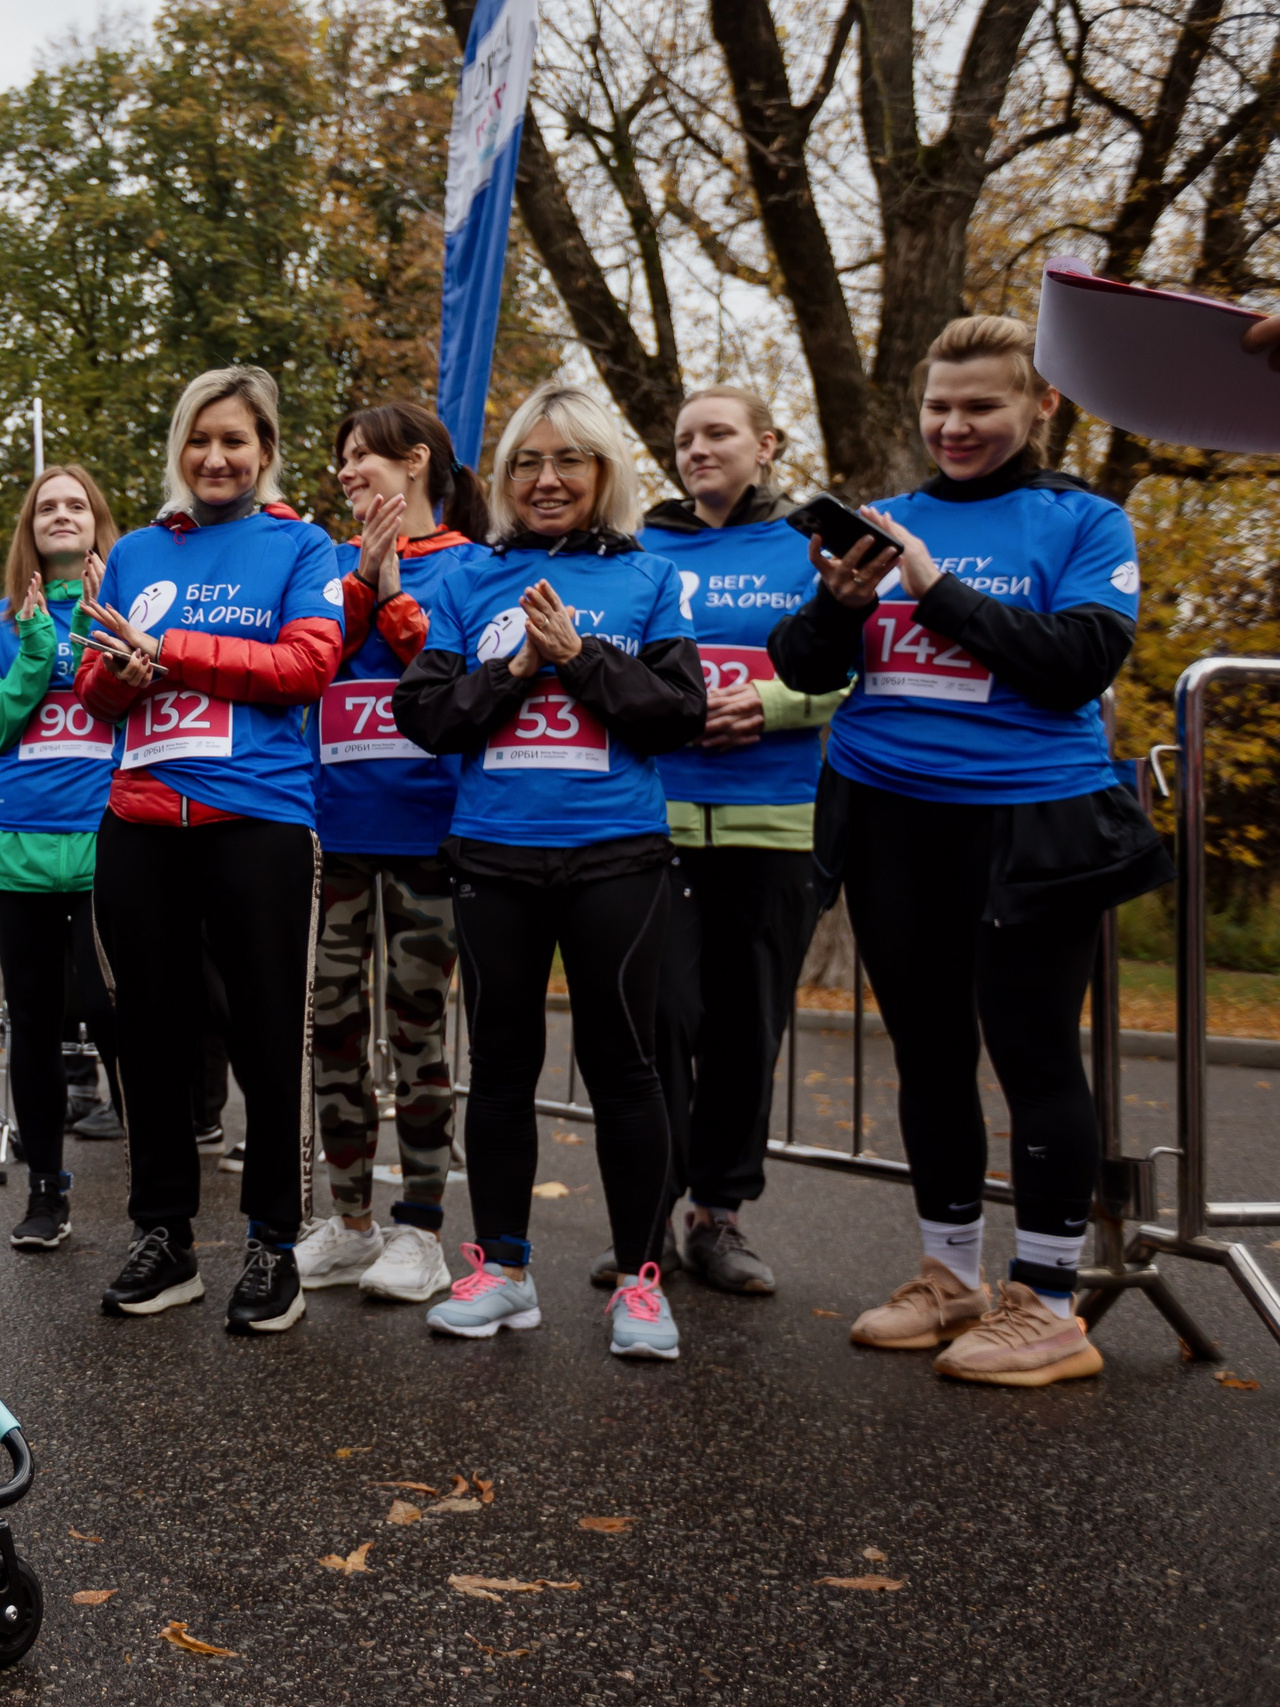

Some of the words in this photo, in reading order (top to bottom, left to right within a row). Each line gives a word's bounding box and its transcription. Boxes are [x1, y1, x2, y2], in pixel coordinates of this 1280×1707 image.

[185, 584, 241, 602] БЕГУ
[708, 575, 767, 590] БЕГУ
[208, 606, 272, 629] ОРБИ
[574, 610, 605, 627] ГУ
[877, 618, 972, 668] 142
[40, 703, 94, 737] 90
[142, 690, 211, 736] 132
[345, 695, 398, 734] 79
[514, 694, 580, 739] 53
[143, 745, 166, 757] ОРБИ
[344, 744, 370, 753] ОРБИ
[510, 750, 538, 759] ОРБИ
[302, 1135, 314, 1212] GUESS
